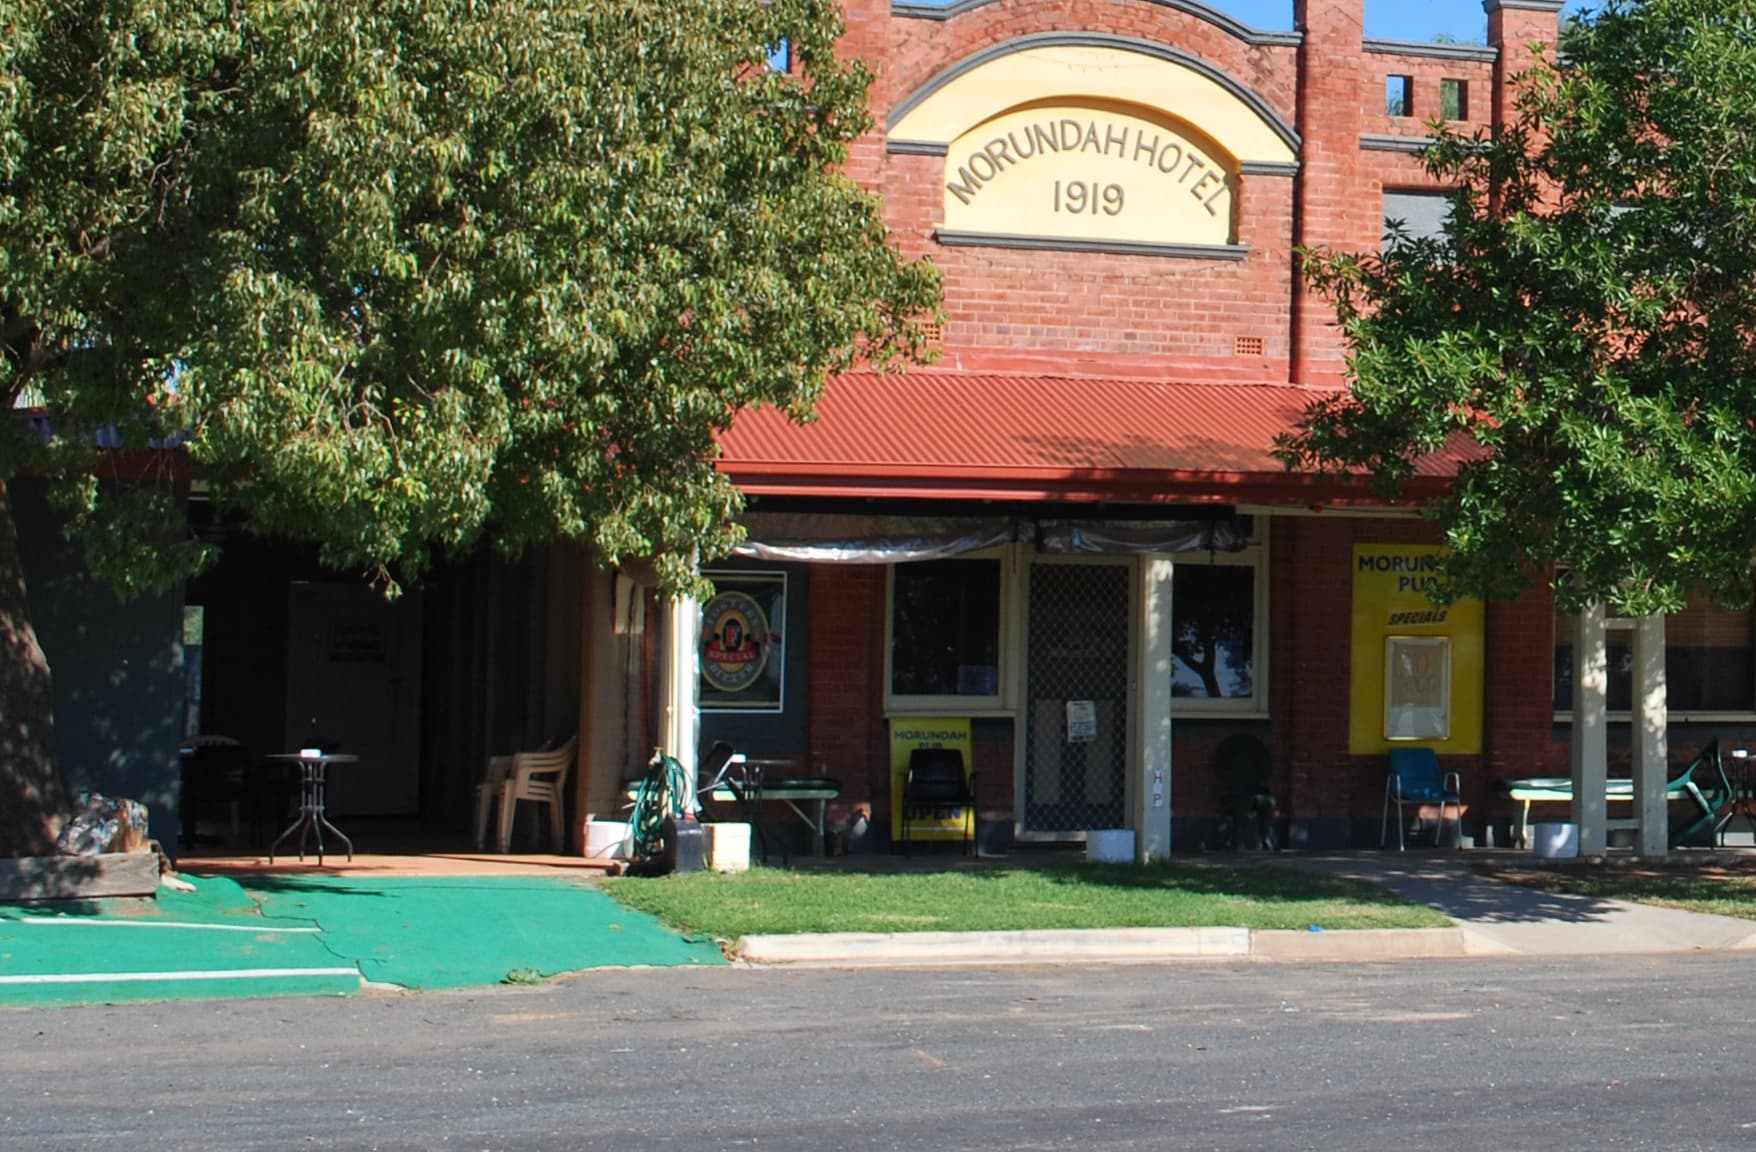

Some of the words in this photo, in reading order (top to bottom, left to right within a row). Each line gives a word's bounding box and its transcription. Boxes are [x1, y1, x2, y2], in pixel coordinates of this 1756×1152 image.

[946, 118, 1128, 206] MORUNDAH
[1133, 128, 1232, 217] HOTEL
[1053, 179, 1125, 216] 1919
[1387, 610, 1448, 626] SPECIALS
[707, 650, 757, 662] SPECIAL
[894, 729, 967, 741] MORUNDAH
